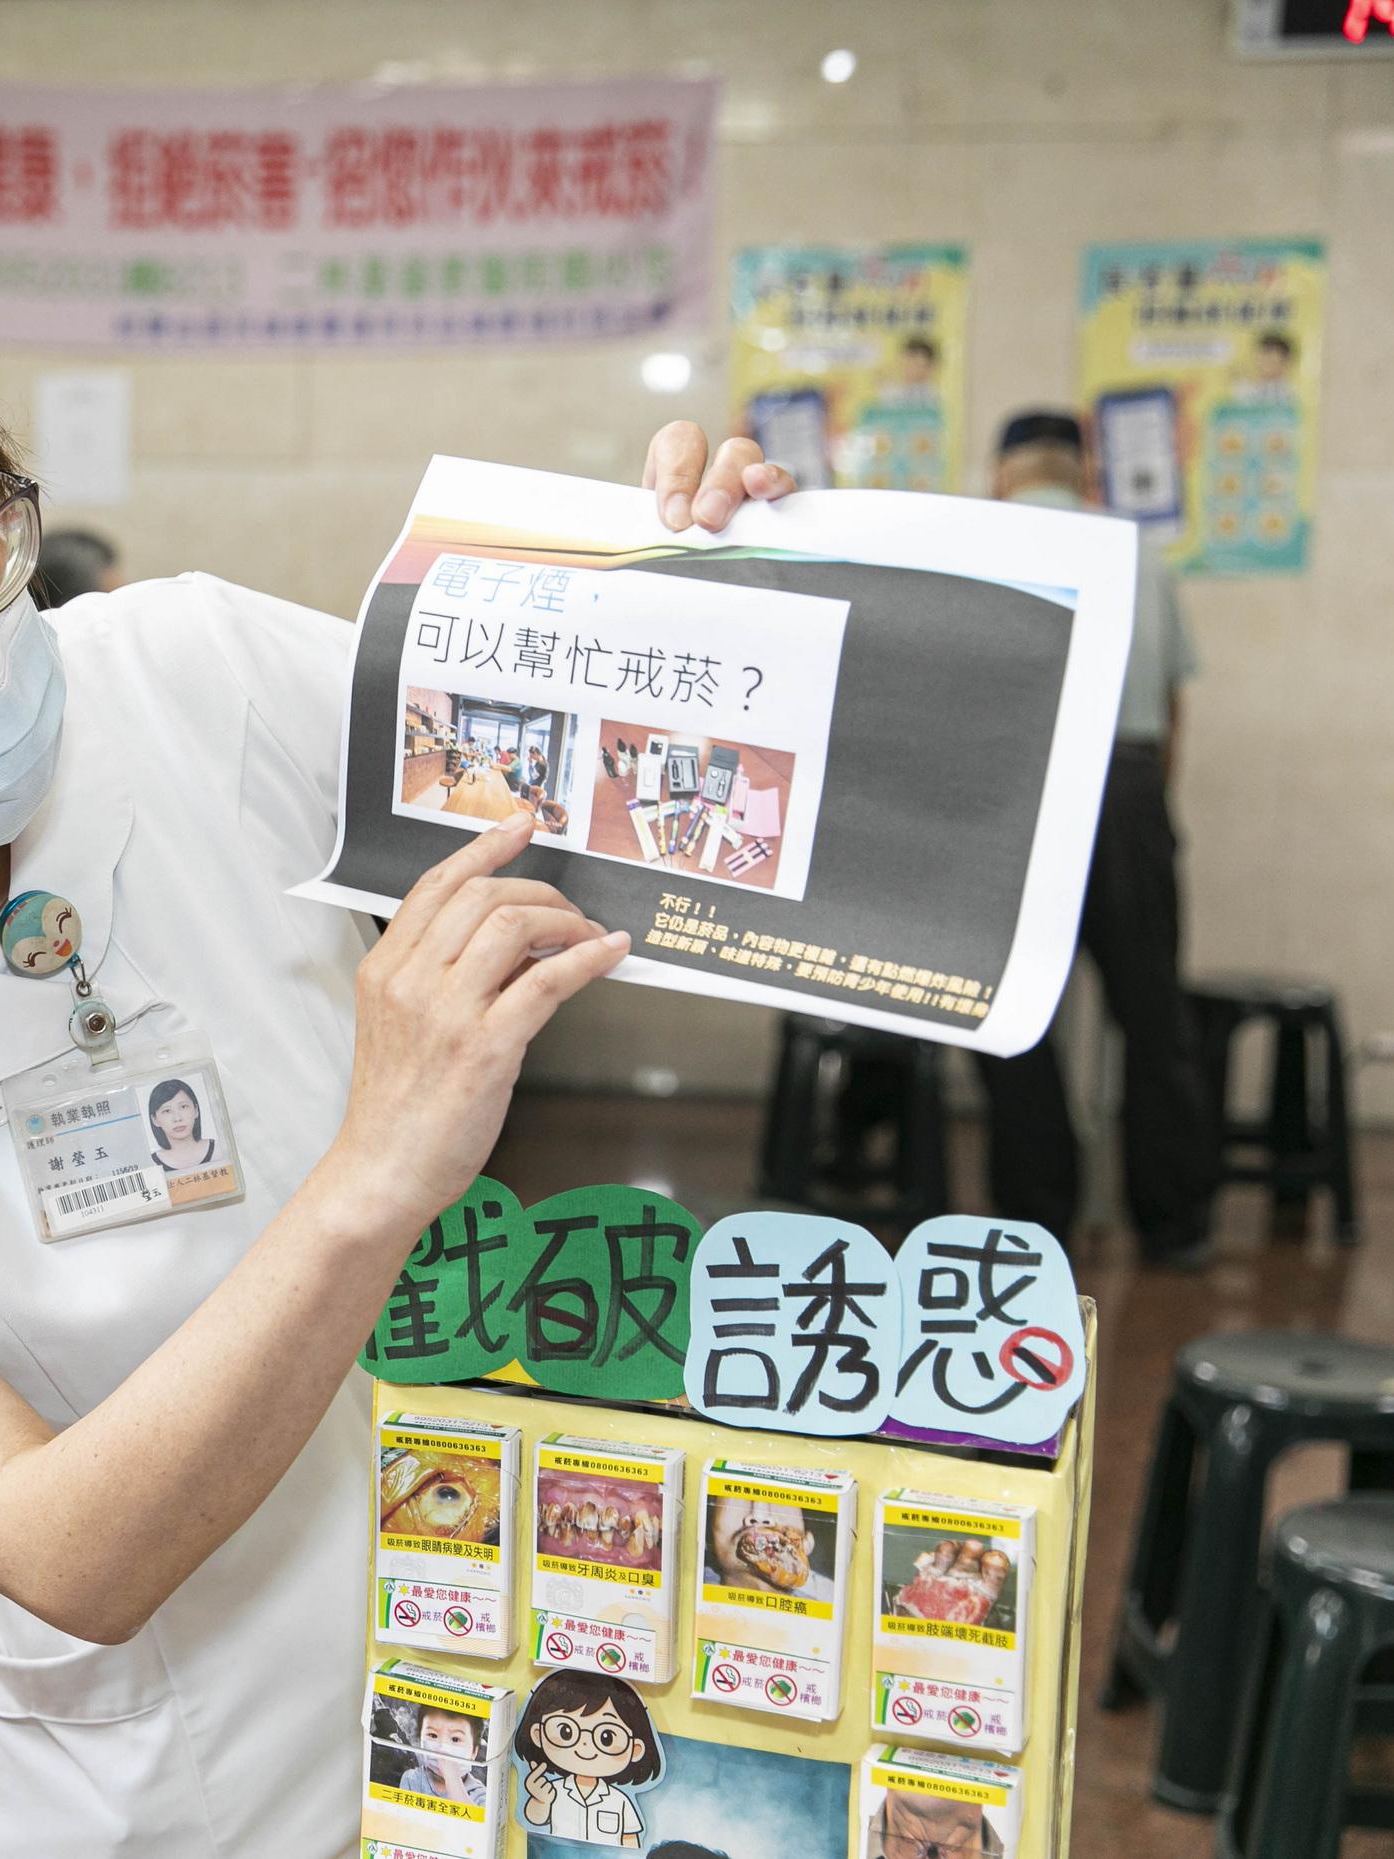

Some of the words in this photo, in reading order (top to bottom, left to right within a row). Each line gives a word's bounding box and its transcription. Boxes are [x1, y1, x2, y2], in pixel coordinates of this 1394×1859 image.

[432, 557, 600, 613] 電子煙，
[416, 610, 763, 711] 可以幫忙戒菸？
[51, 1100, 111, 1127] 執業執照
